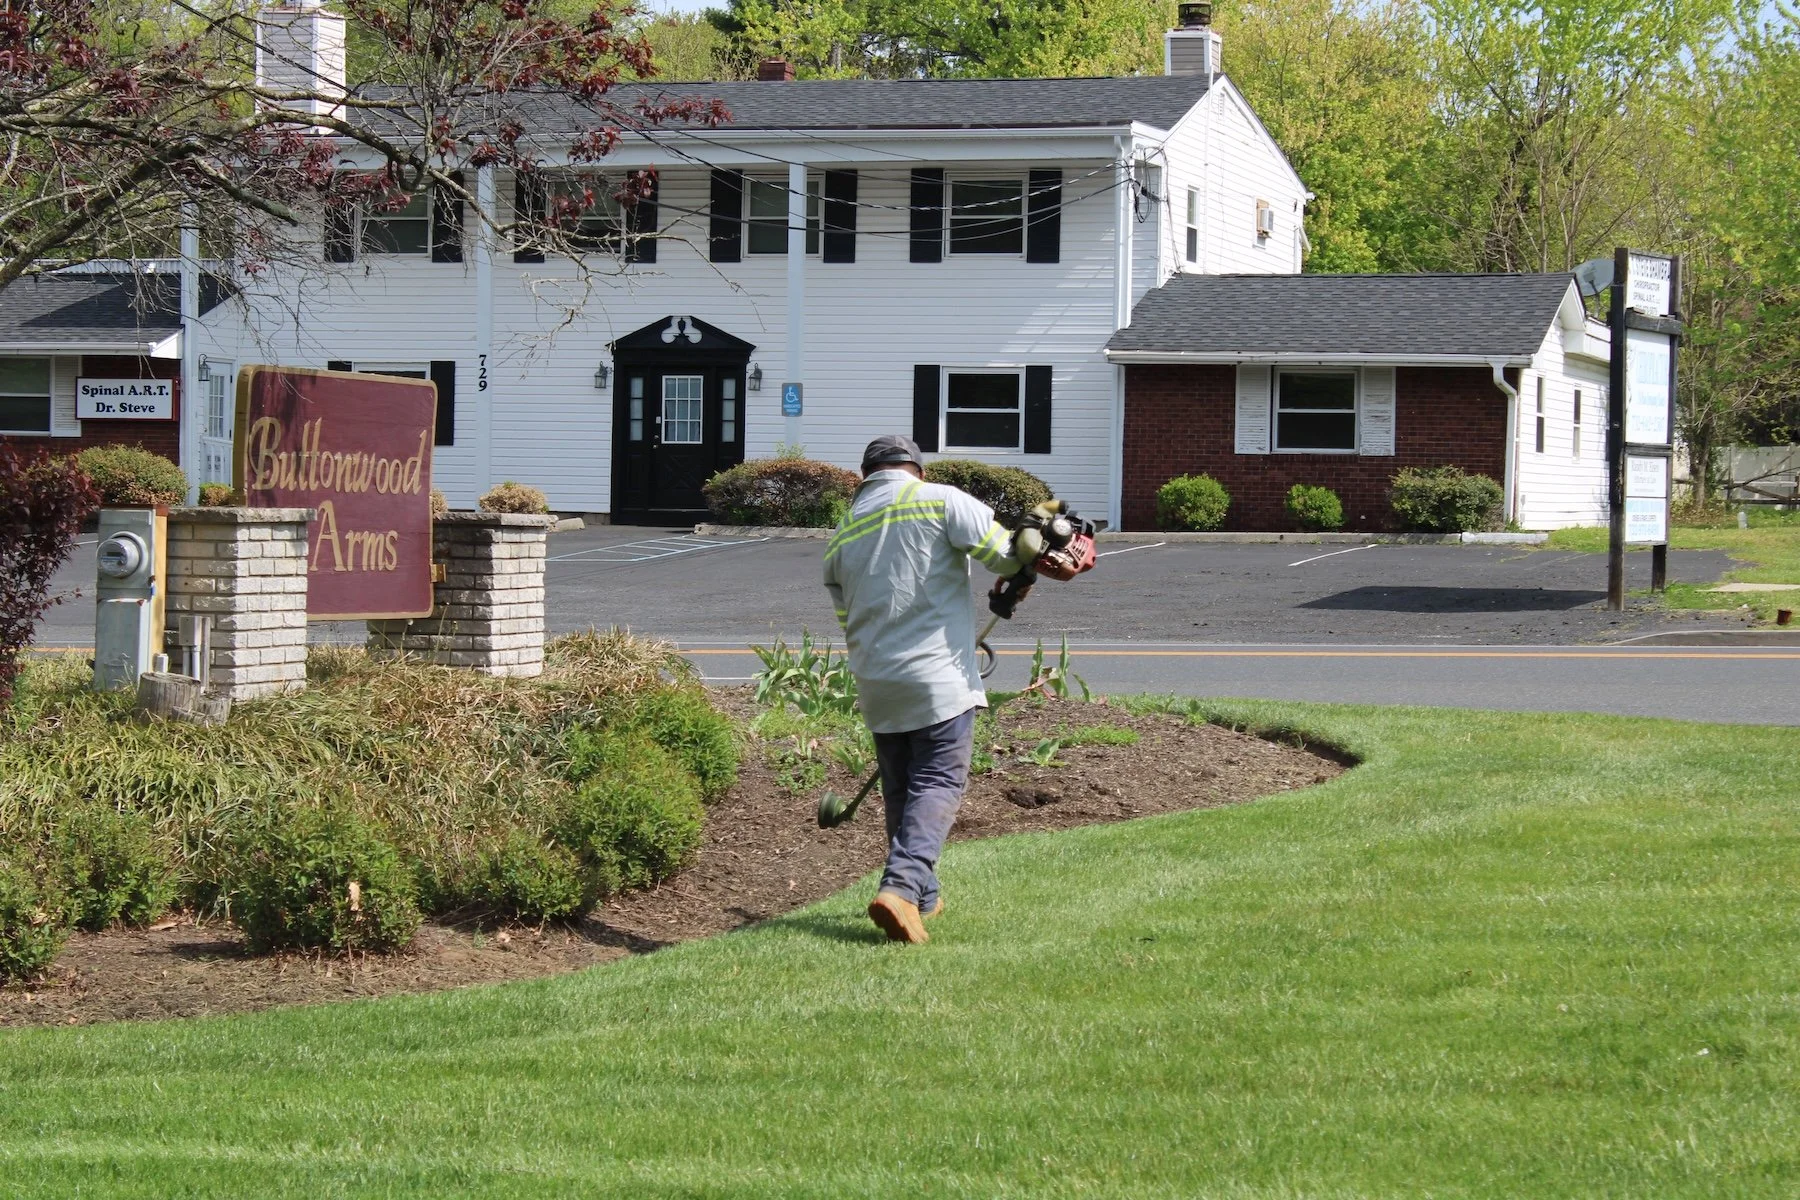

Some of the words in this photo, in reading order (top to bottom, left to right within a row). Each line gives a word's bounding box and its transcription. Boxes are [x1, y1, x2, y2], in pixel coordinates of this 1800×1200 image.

[81, 384, 125, 397] Spinal
[127, 385, 169, 396] A.R.T.
[478, 354, 488, 392] 729
[95, 402, 116, 413] Dr.
[119, 402, 156, 413] Steve
[249, 416, 427, 495] Buttonwood
[309, 500, 399, 572] Arms
